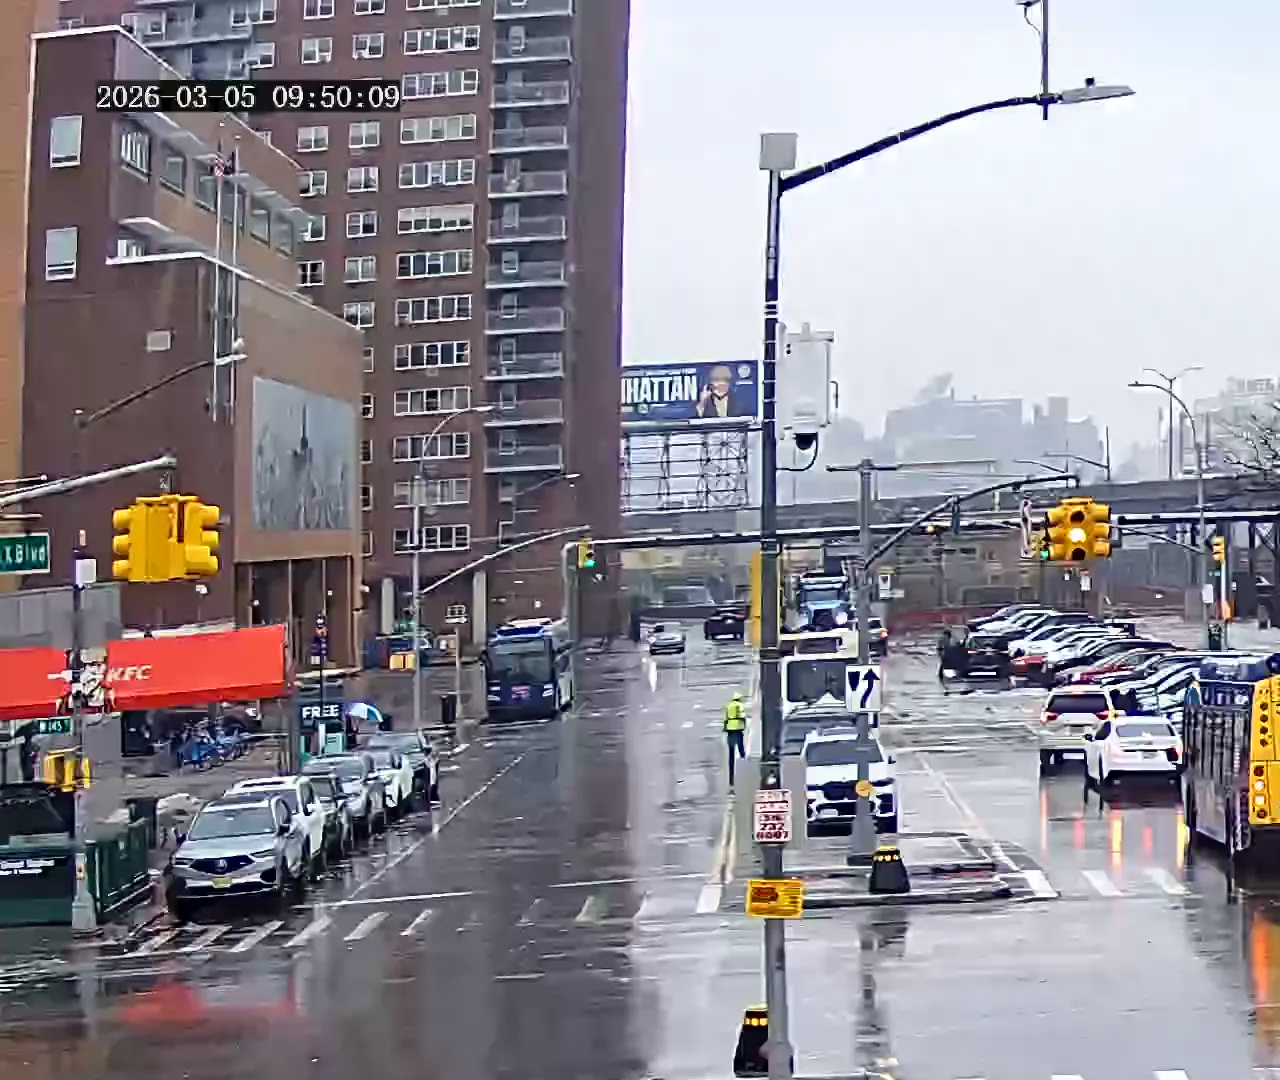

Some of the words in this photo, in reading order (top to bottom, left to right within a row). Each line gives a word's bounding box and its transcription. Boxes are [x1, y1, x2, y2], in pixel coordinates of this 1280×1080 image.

[621, 375, 697, 404] HATTAN
[15, 543, 46, 564] Blvd
[106, 664, 152, 682] KFC
[302, 703, 340, 718] FREE
